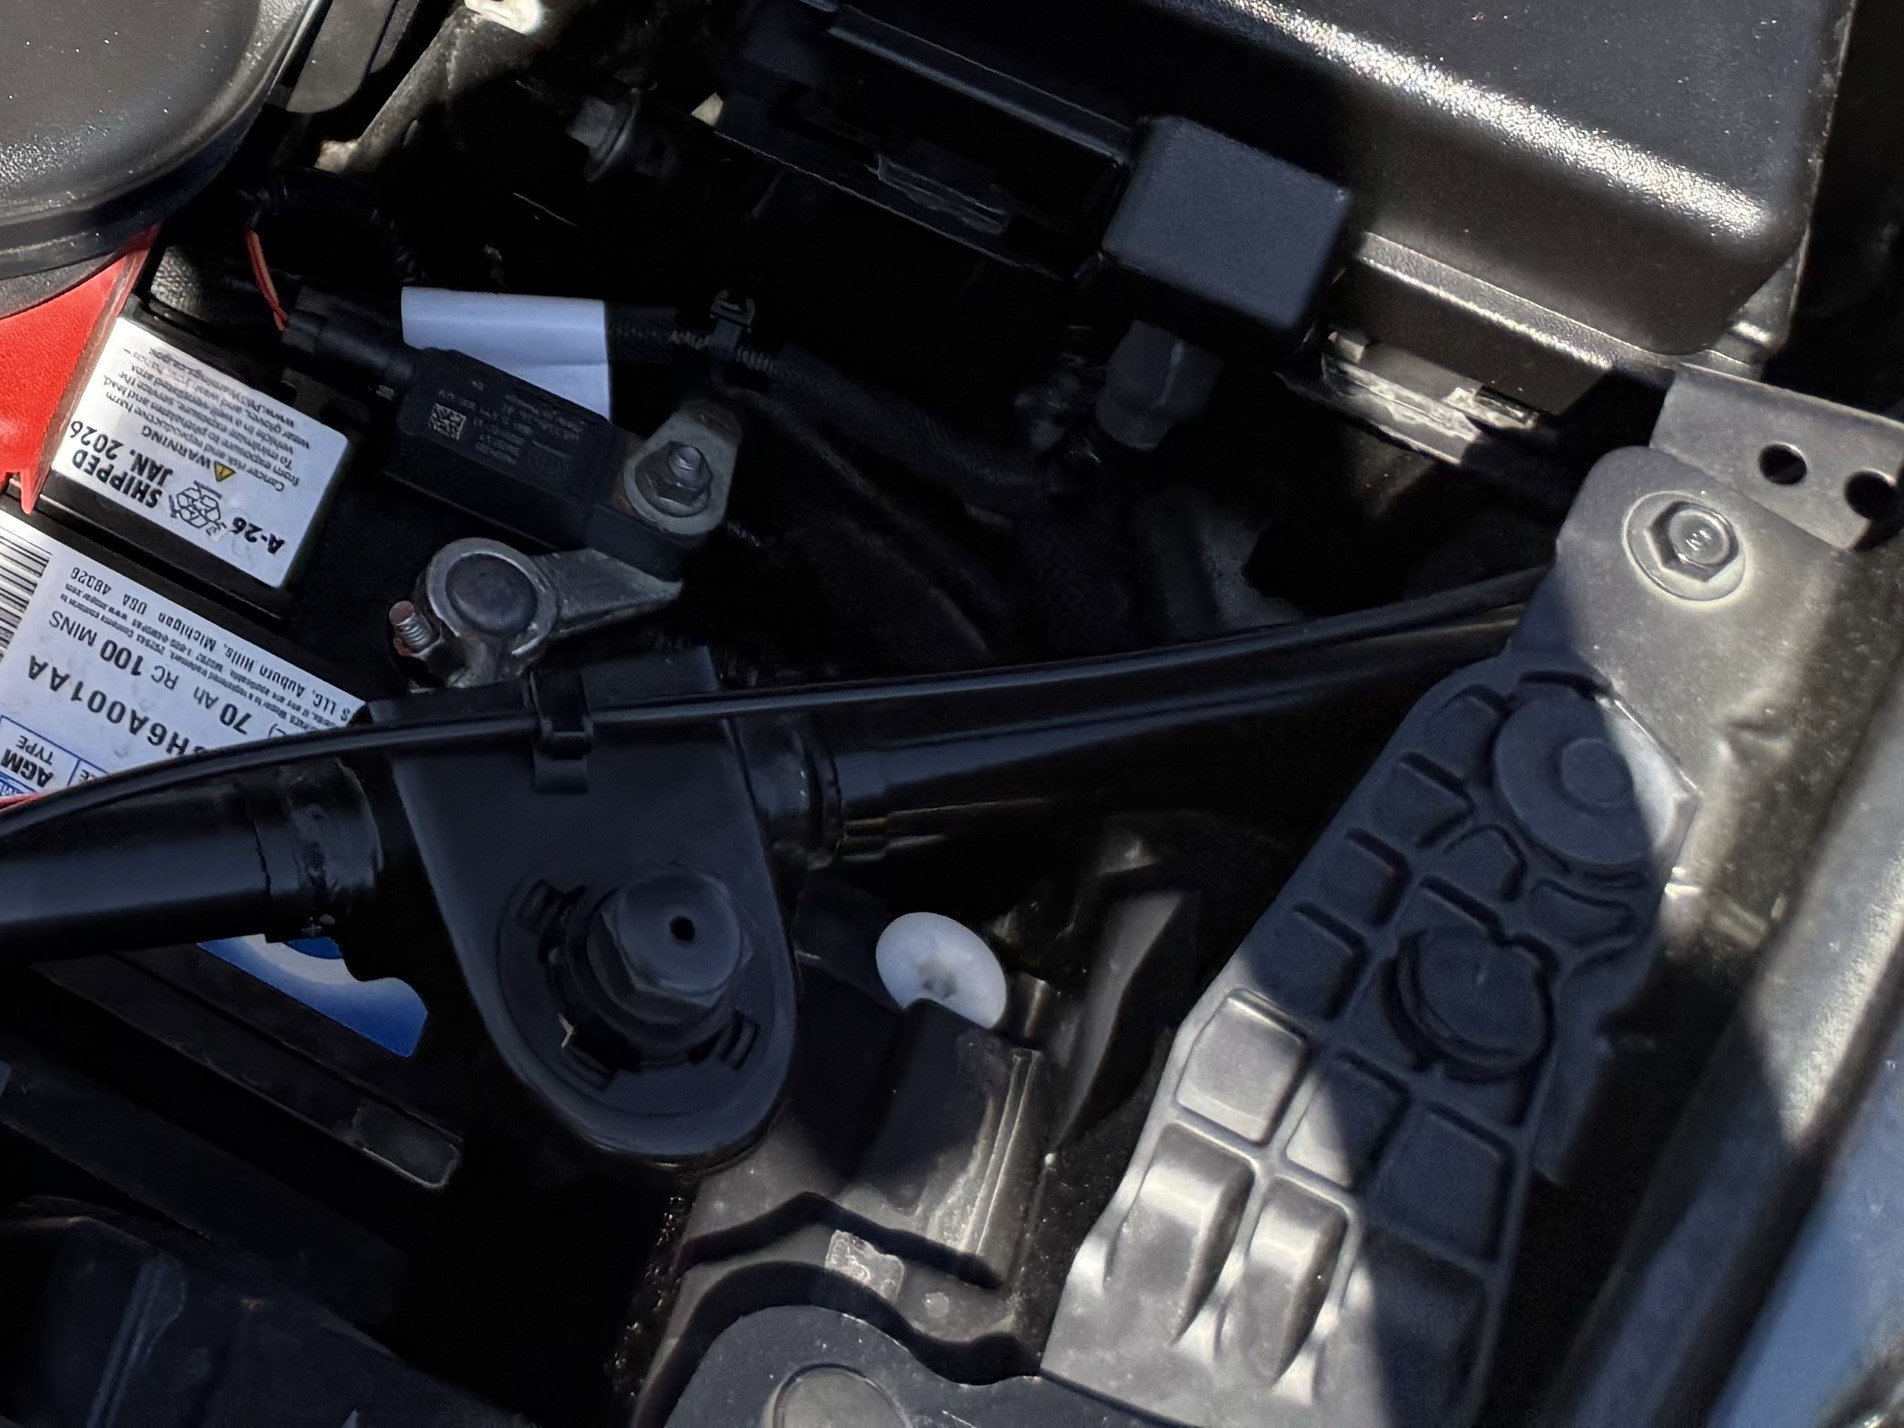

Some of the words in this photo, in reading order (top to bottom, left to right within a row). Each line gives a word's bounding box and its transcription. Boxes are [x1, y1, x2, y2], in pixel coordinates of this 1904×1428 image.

[64, 417, 123, 461] 2026
[139, 424, 212, 469] WARNING
[69, 446, 163, 509] SHIPPED
[121, 448, 174, 488] JAN.
[227, 514, 285, 557] A-26
[69, 565, 113, 597] 48326
[119, 592, 148, 616] USA
[46, 609, 98, 647] MINS
[154, 609, 218, 652] Michigan
[97, 637, 148, 678] 100
[217, 643, 256, 672] Hills,
[148, 663, 180, 690] RC
[256, 663, 306, 698] Auburn
[189, 685, 219, 711] Ah
[306, 689, 338, 715] LLC,
[216, 700, 255, 735] 70
[14, 734, 58, 766] TYPE
